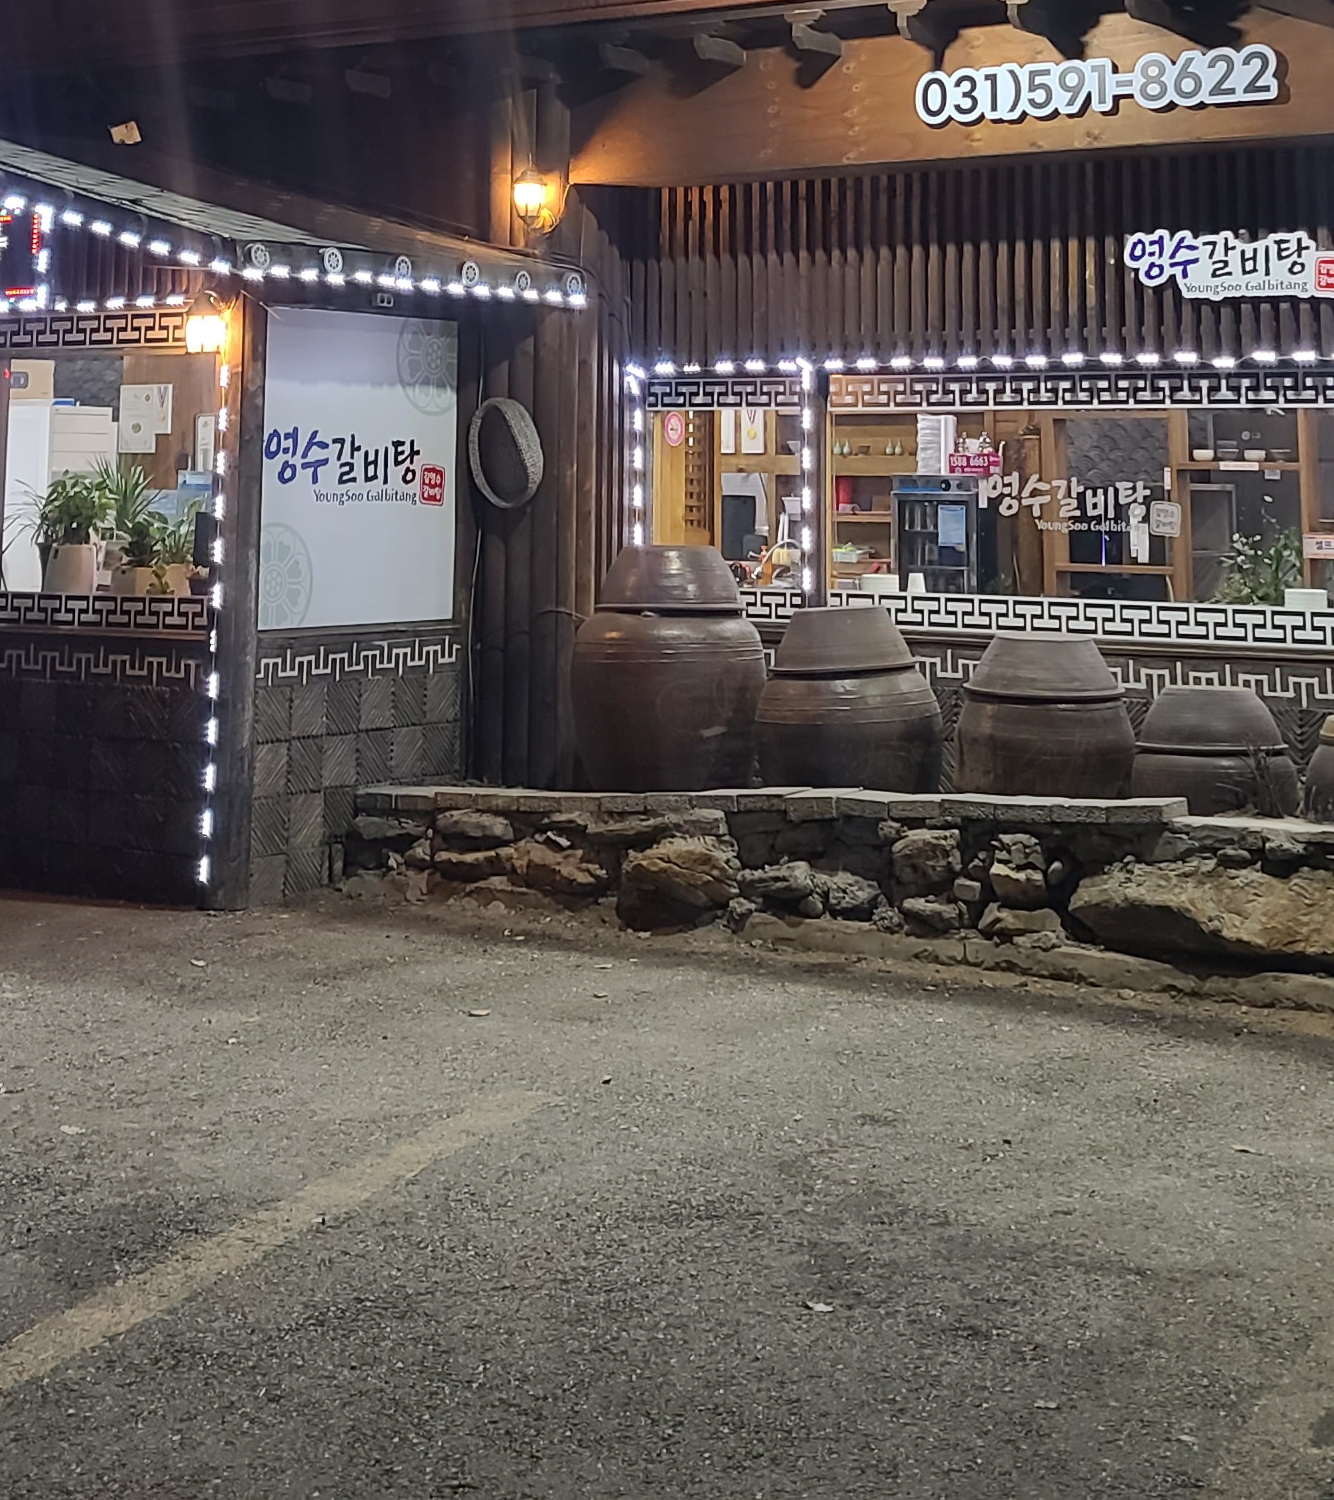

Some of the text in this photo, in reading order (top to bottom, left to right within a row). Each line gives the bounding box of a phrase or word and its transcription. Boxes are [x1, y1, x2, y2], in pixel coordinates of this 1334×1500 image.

[921, 49, 1273, 120] 031)591-8622
[1128, 235, 1310, 280] 영수갈비탕
[1183, 280, 1309, 295] YoungSoo Galbitang
[264, 426, 420, 485] 영수갈비탕
[313, 488, 417, 506] YoungSoo Galbitang
[987, 471, 1151, 518] 영수갈비탕
[1034, 518, 1088, 533] YoungSoo
